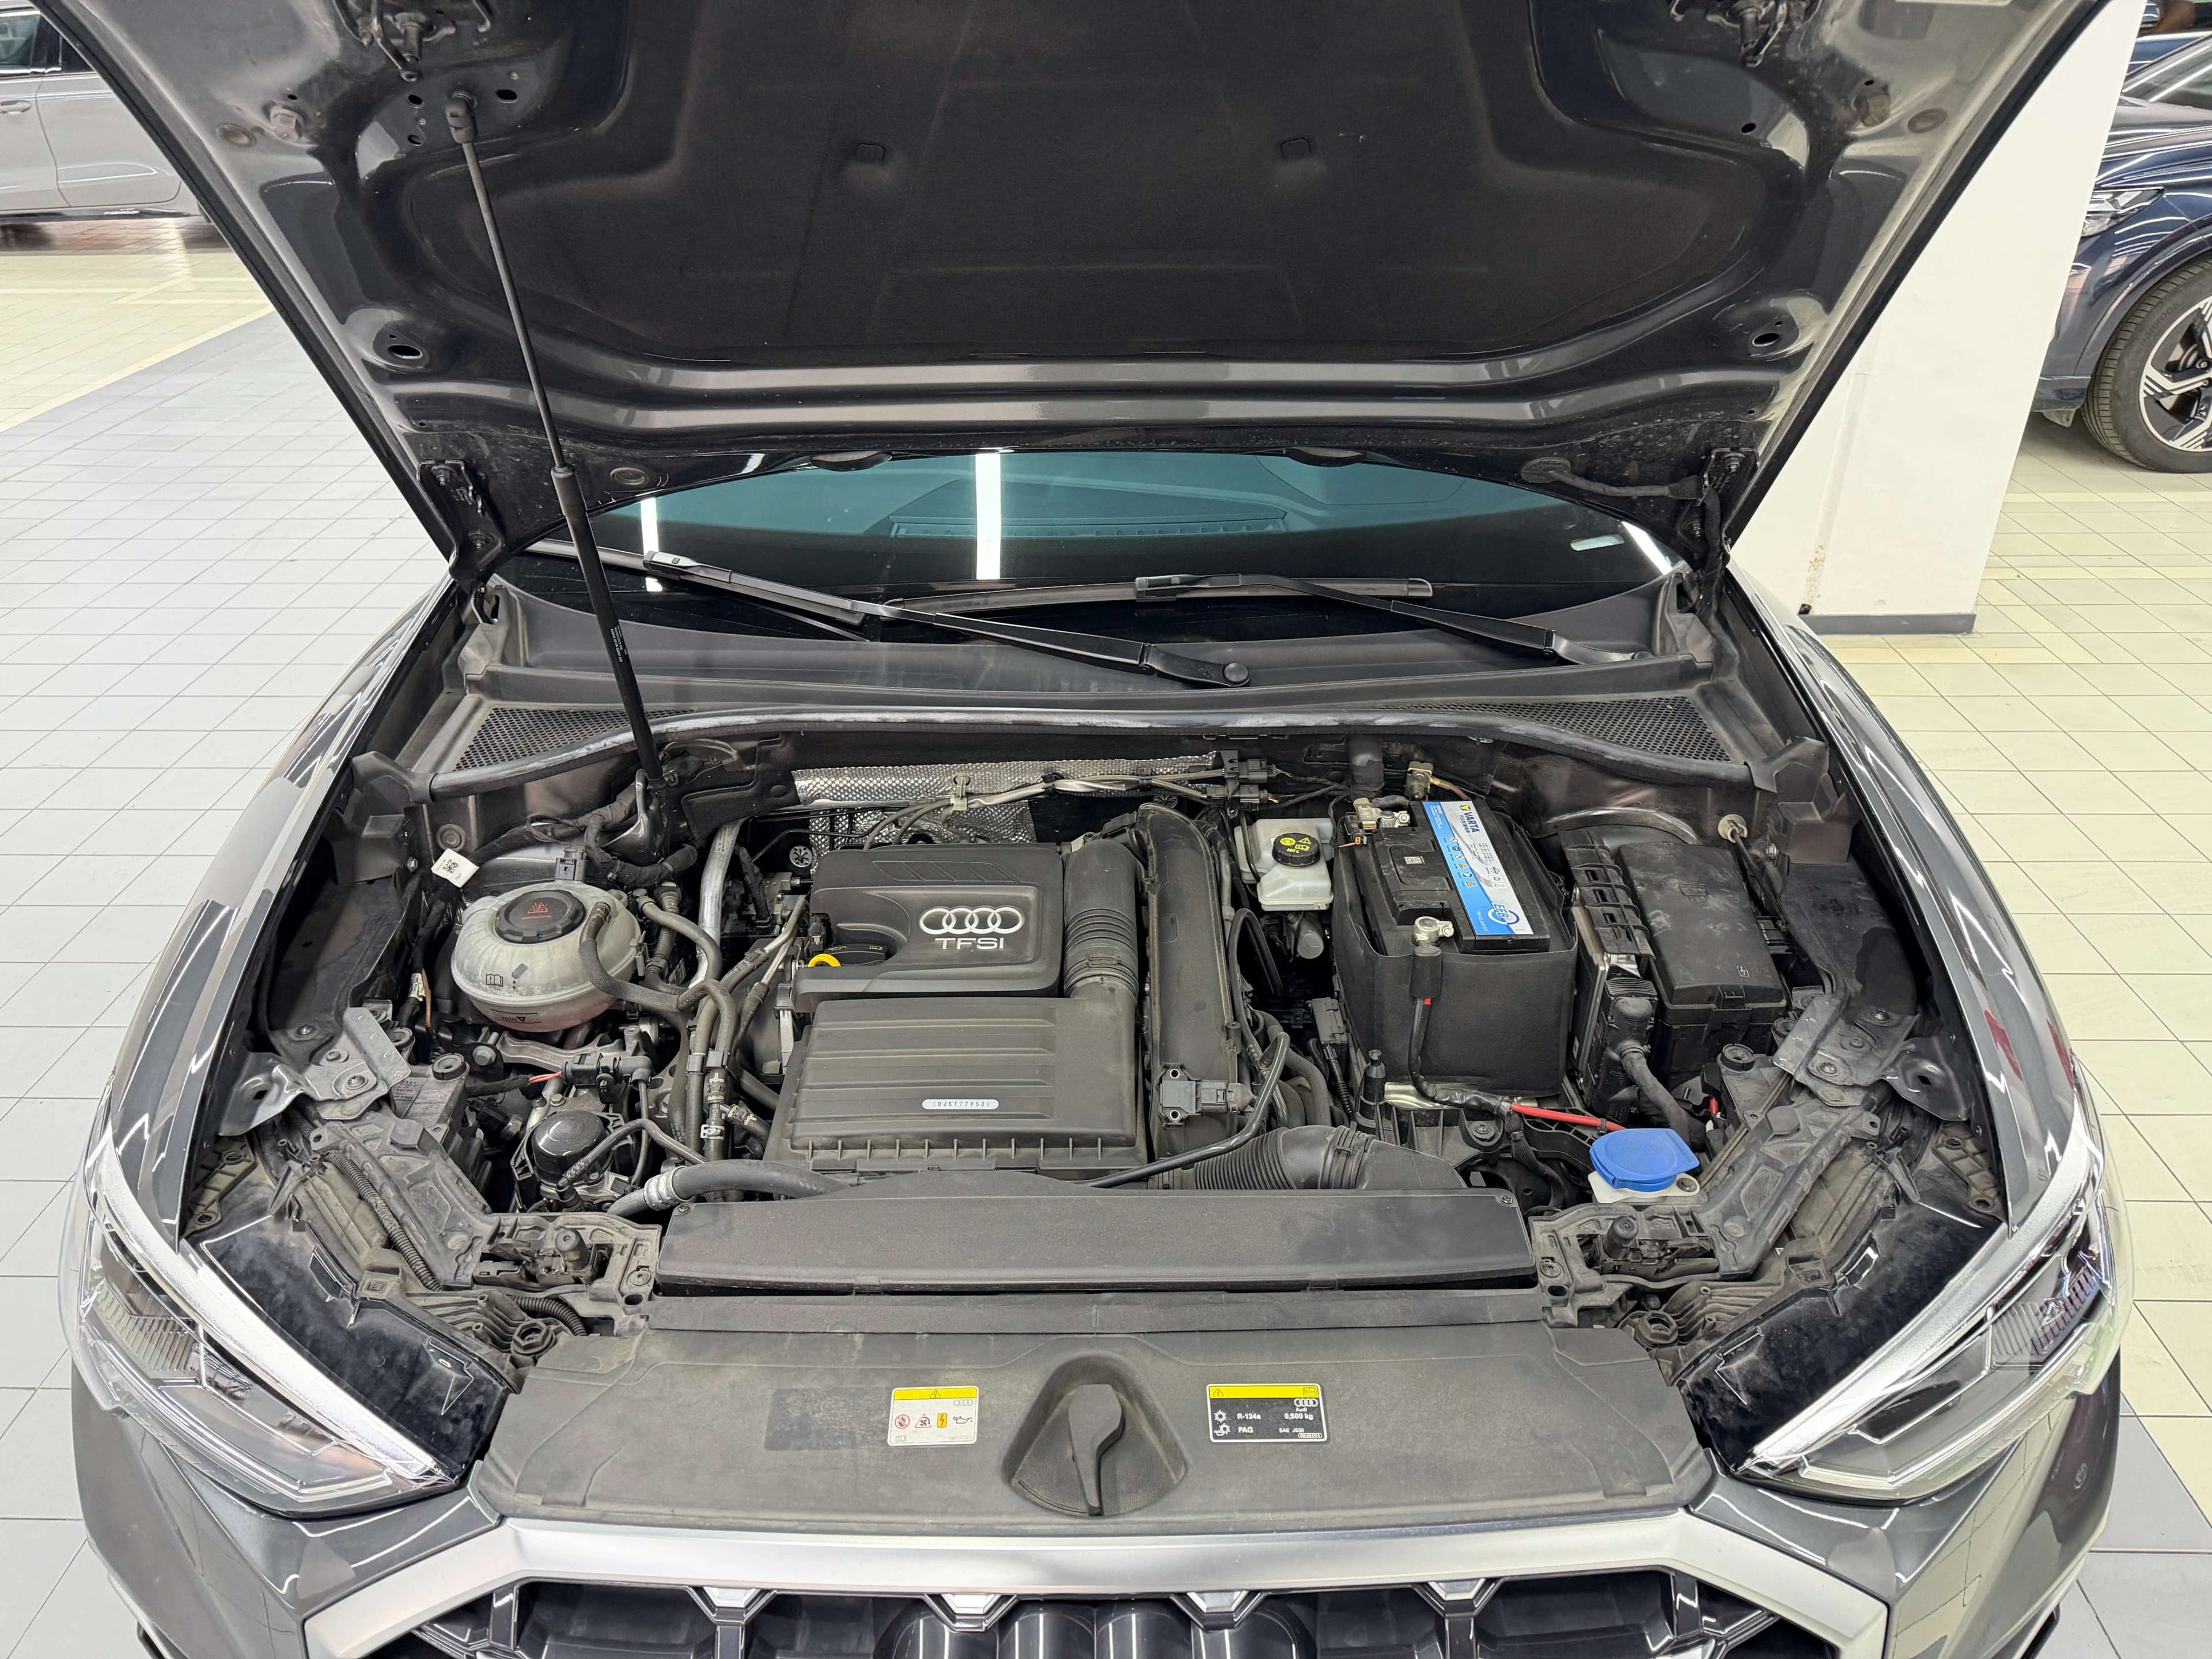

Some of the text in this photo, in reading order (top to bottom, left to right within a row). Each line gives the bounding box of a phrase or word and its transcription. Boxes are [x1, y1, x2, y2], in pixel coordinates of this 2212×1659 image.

[1464, 812, 1480, 833] VARTA
[1493, 903, 1510, 918] EFB
[935, 937, 1004, 950] TFSI
